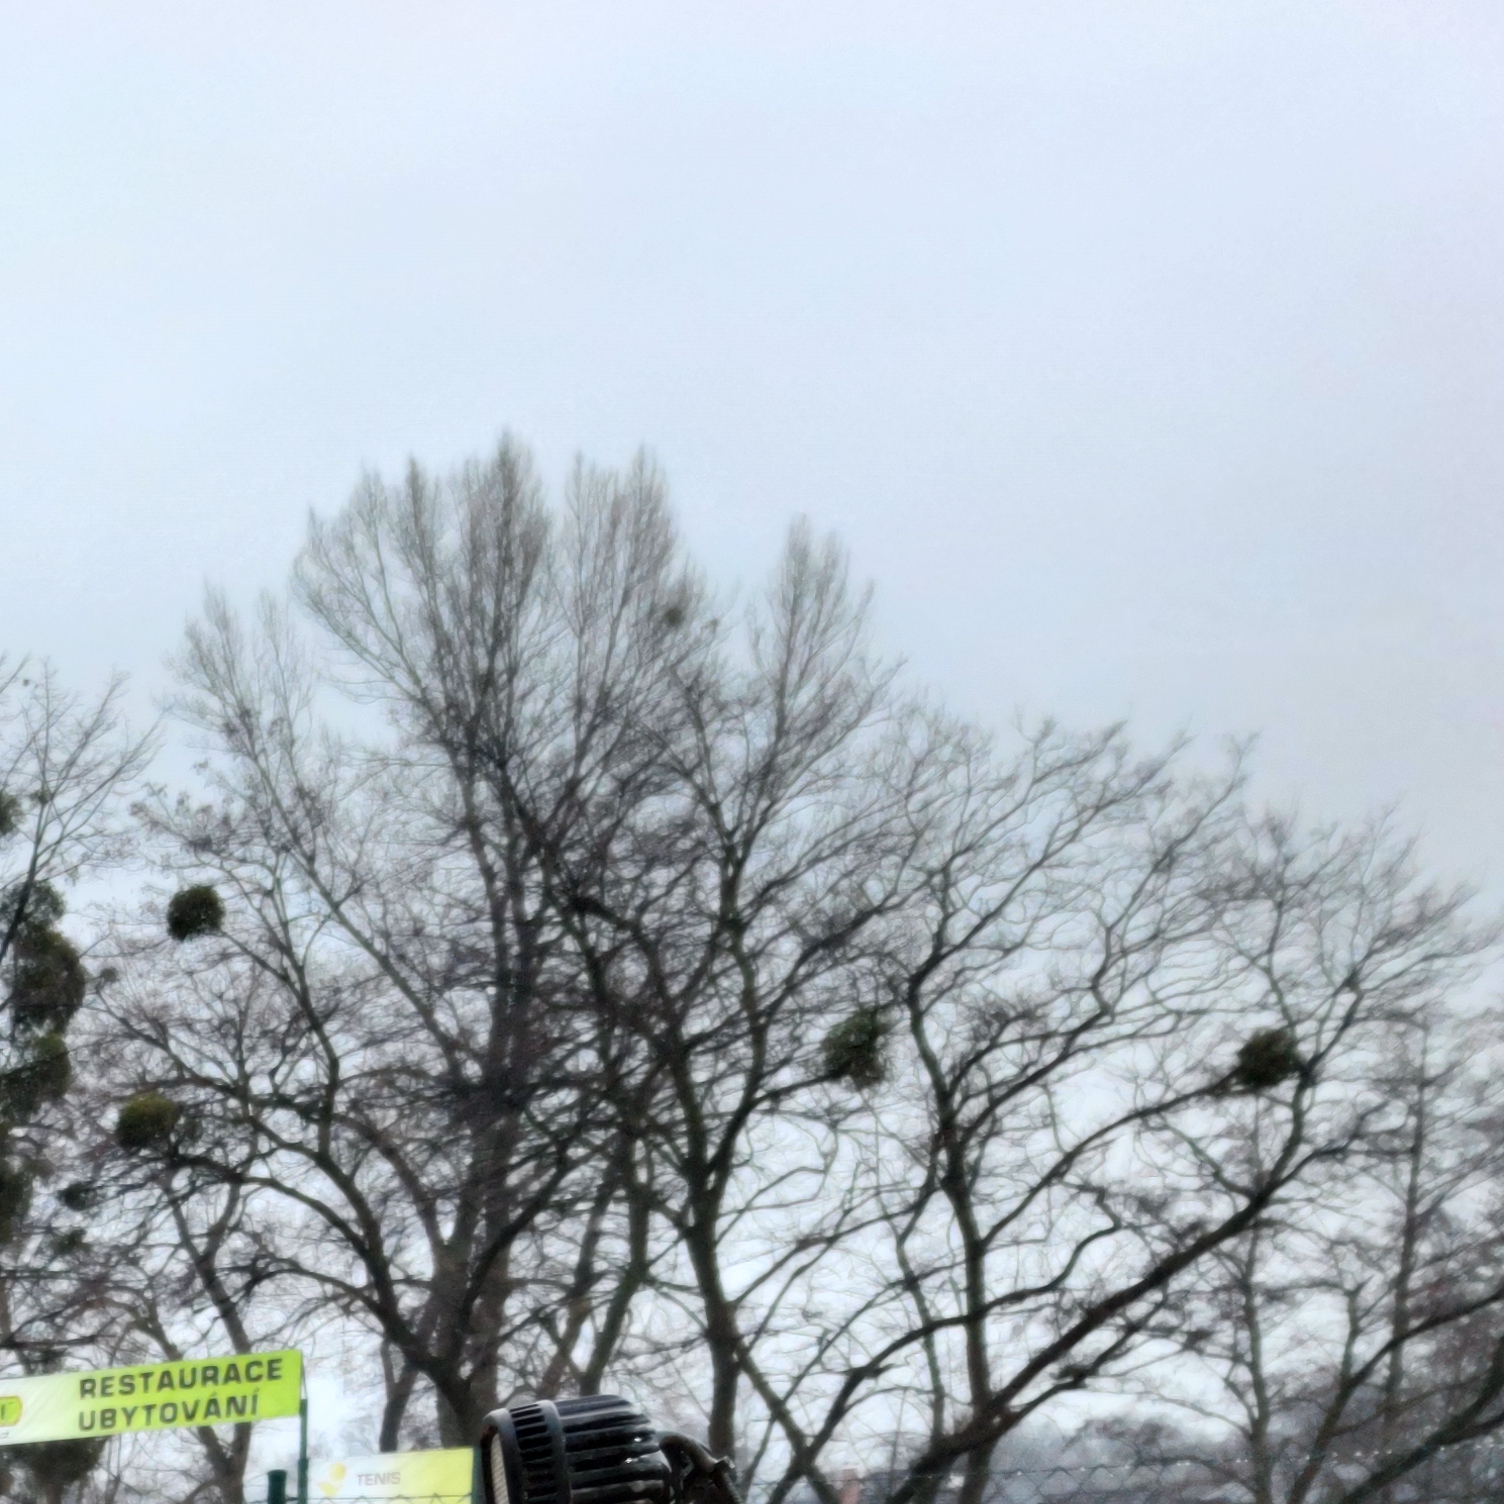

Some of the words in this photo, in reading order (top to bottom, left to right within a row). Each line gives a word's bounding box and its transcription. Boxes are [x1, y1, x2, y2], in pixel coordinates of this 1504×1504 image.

[80, 1358, 283, 1400] RESTAURACE
[79, 1387, 259, 1431] UBYTOVÁNÍ
[357, 1472, 402, 1486] TENIS
